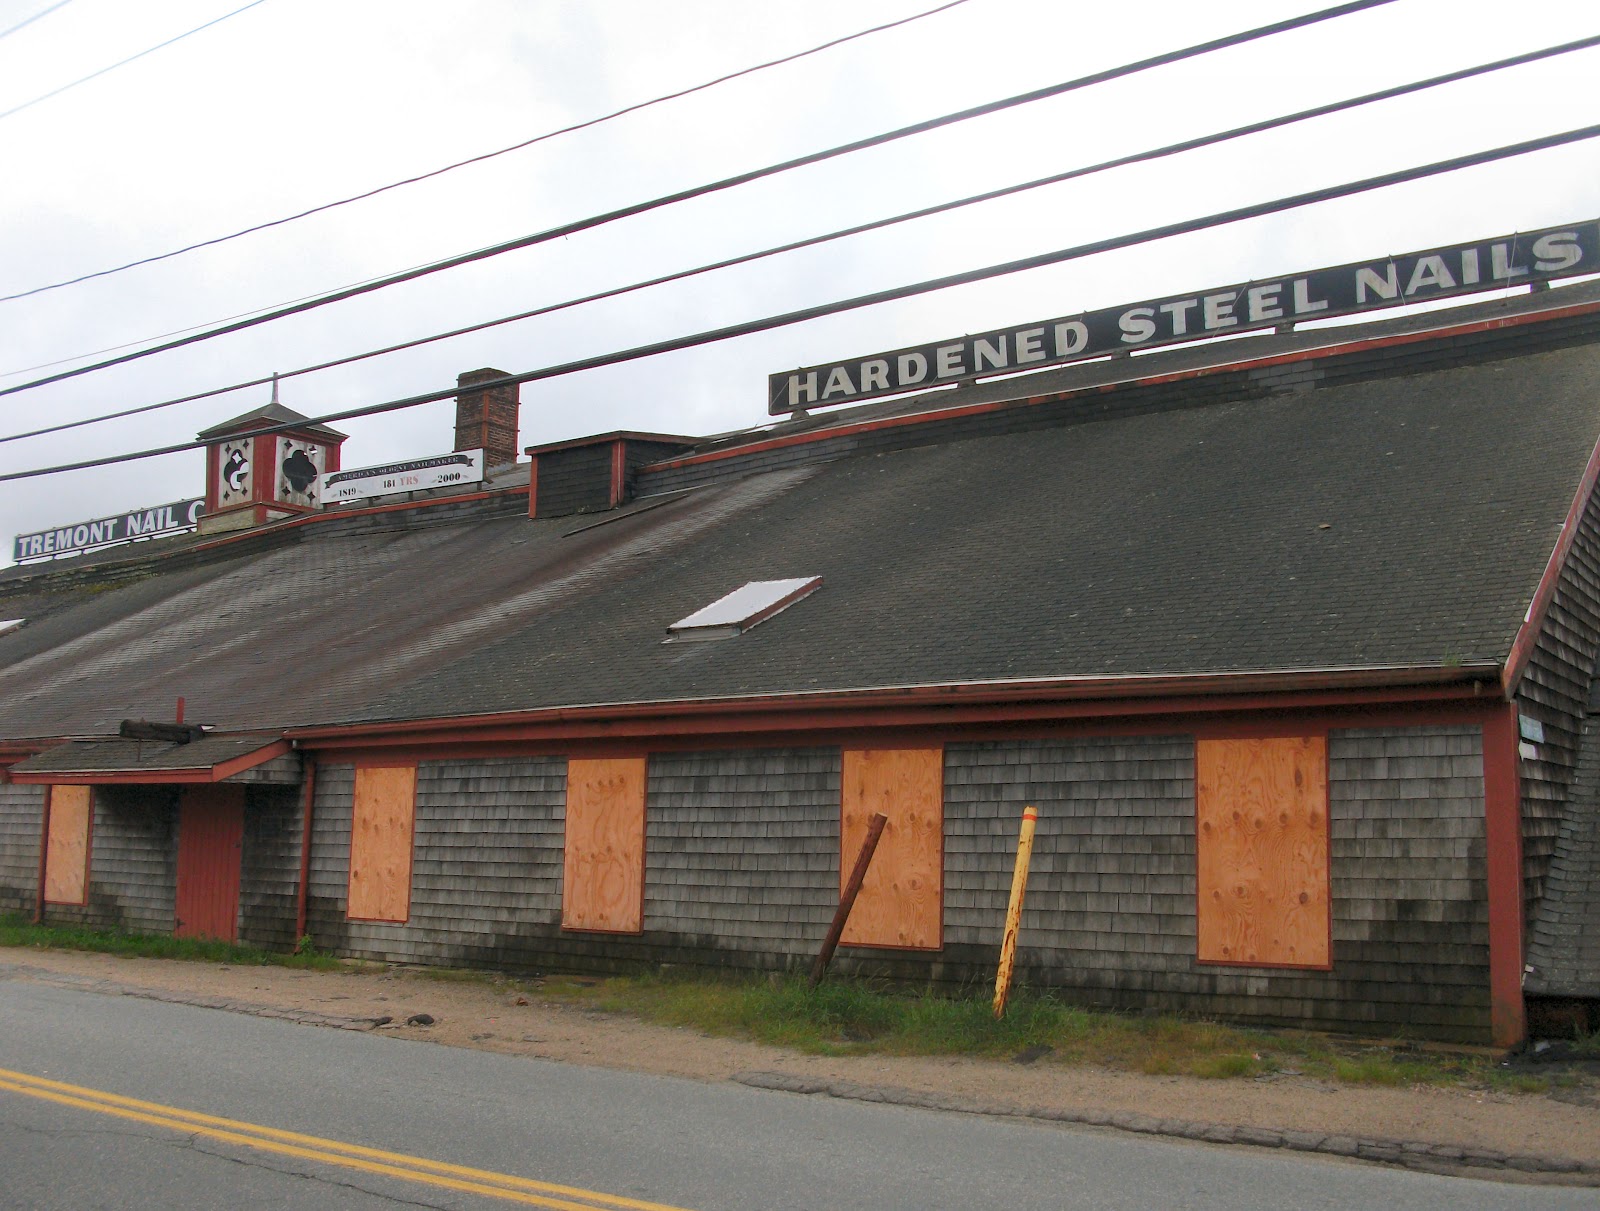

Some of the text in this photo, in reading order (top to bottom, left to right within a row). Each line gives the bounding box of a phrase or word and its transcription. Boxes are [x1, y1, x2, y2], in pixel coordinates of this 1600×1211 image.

[788, 232, 1583, 406] HARDENED STEEL NAILS
[338, 470, 376, 481] AMERICA'S
[339, 472, 461, 497] 1819 181 YRS 2000
[18, 518, 118, 558] TREMONT
[126, 506, 179, 537] NAIL
